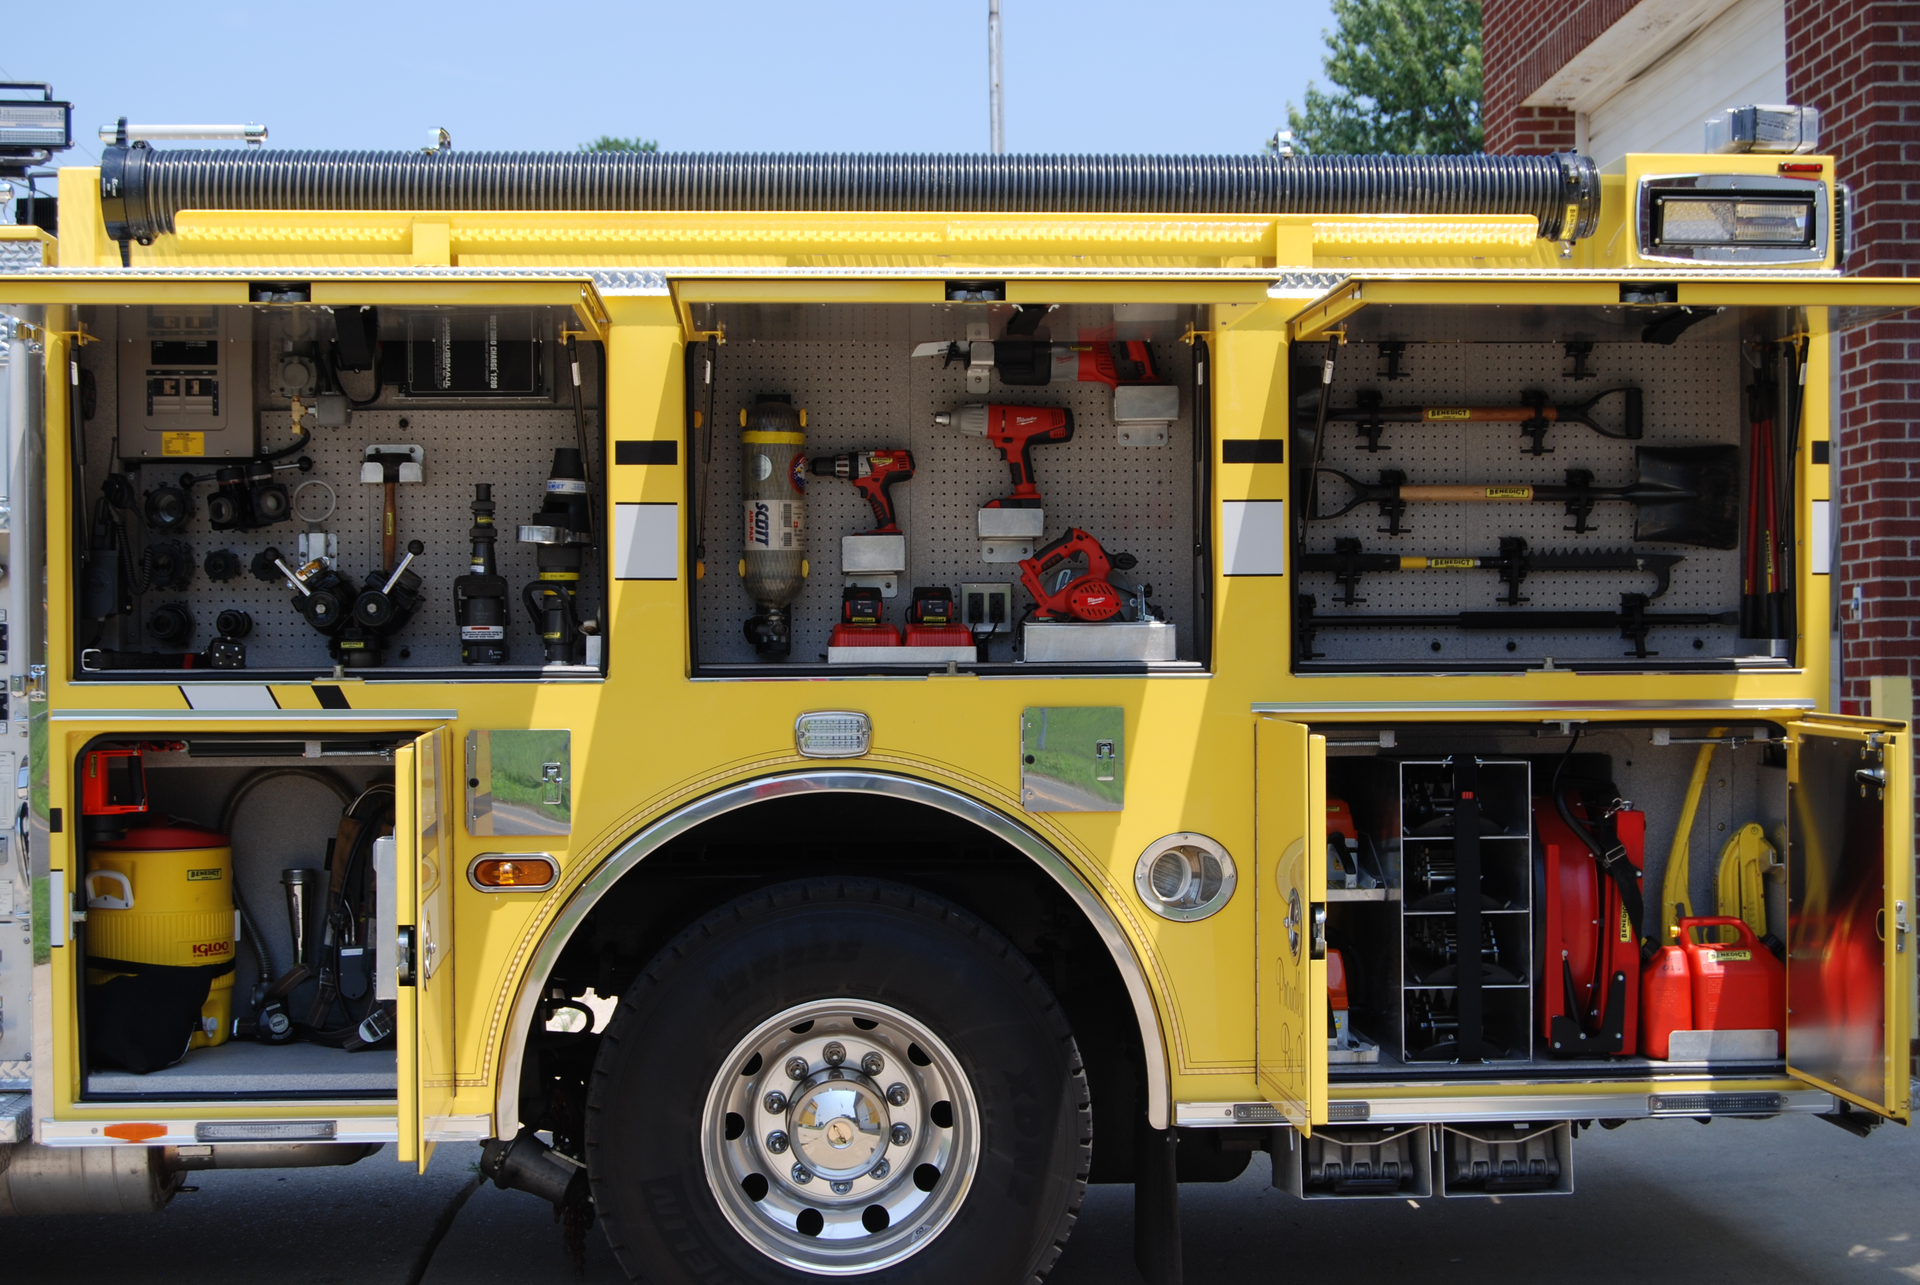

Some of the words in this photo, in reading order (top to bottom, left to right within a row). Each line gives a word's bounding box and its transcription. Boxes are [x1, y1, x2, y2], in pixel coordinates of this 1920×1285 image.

[1431, 409, 1467, 417] BENEDICT
[755, 502, 769, 548] SCOTT
[1434, 558, 1470, 566] BENEDICT
[193, 941, 229, 957] IGLOO
[1710, 951, 1747, 959] BENEDICT
[1275, 957, 1304, 1035] Proudly
